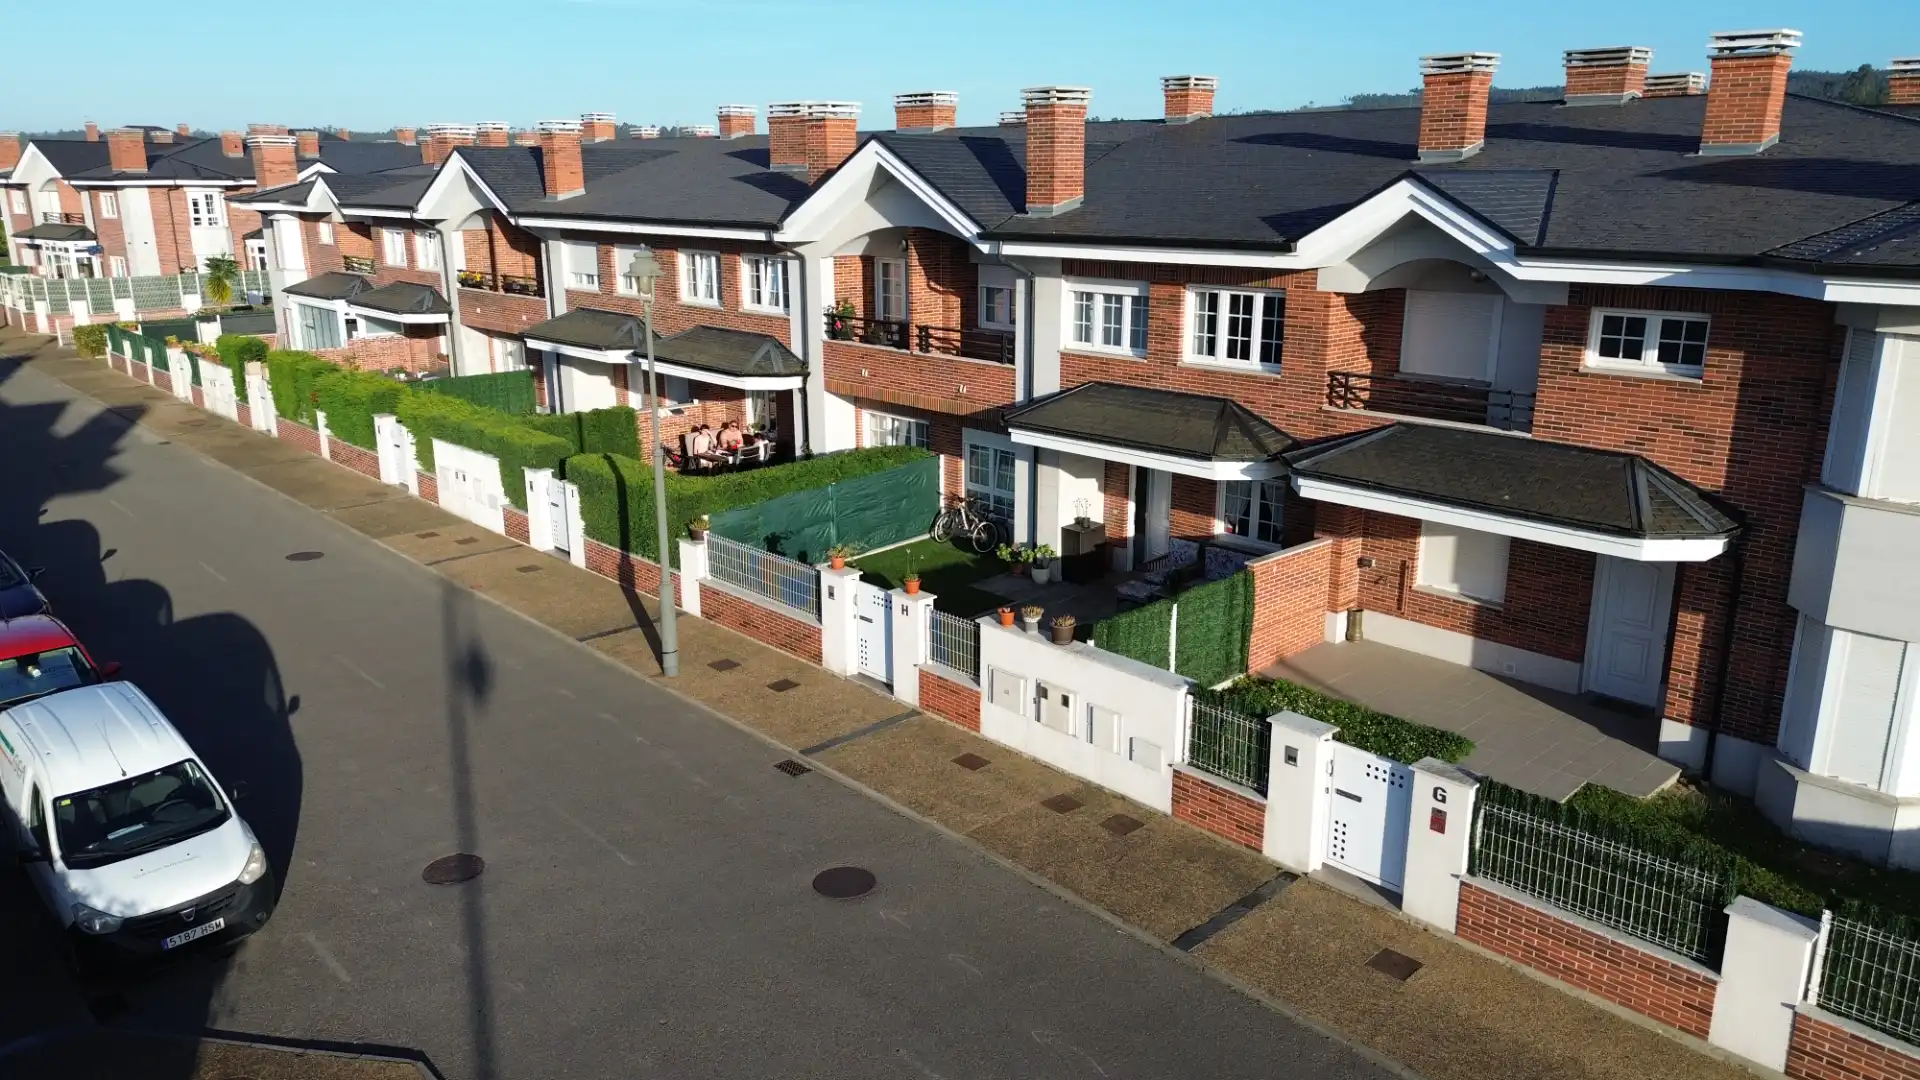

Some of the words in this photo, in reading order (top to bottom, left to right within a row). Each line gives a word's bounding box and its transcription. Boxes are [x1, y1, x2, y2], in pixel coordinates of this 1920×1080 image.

[901, 604, 909, 616] H
[1432, 786, 1447, 804] G
[169, 929, 197, 947] 5187
[200, 920, 222, 935] HSM
